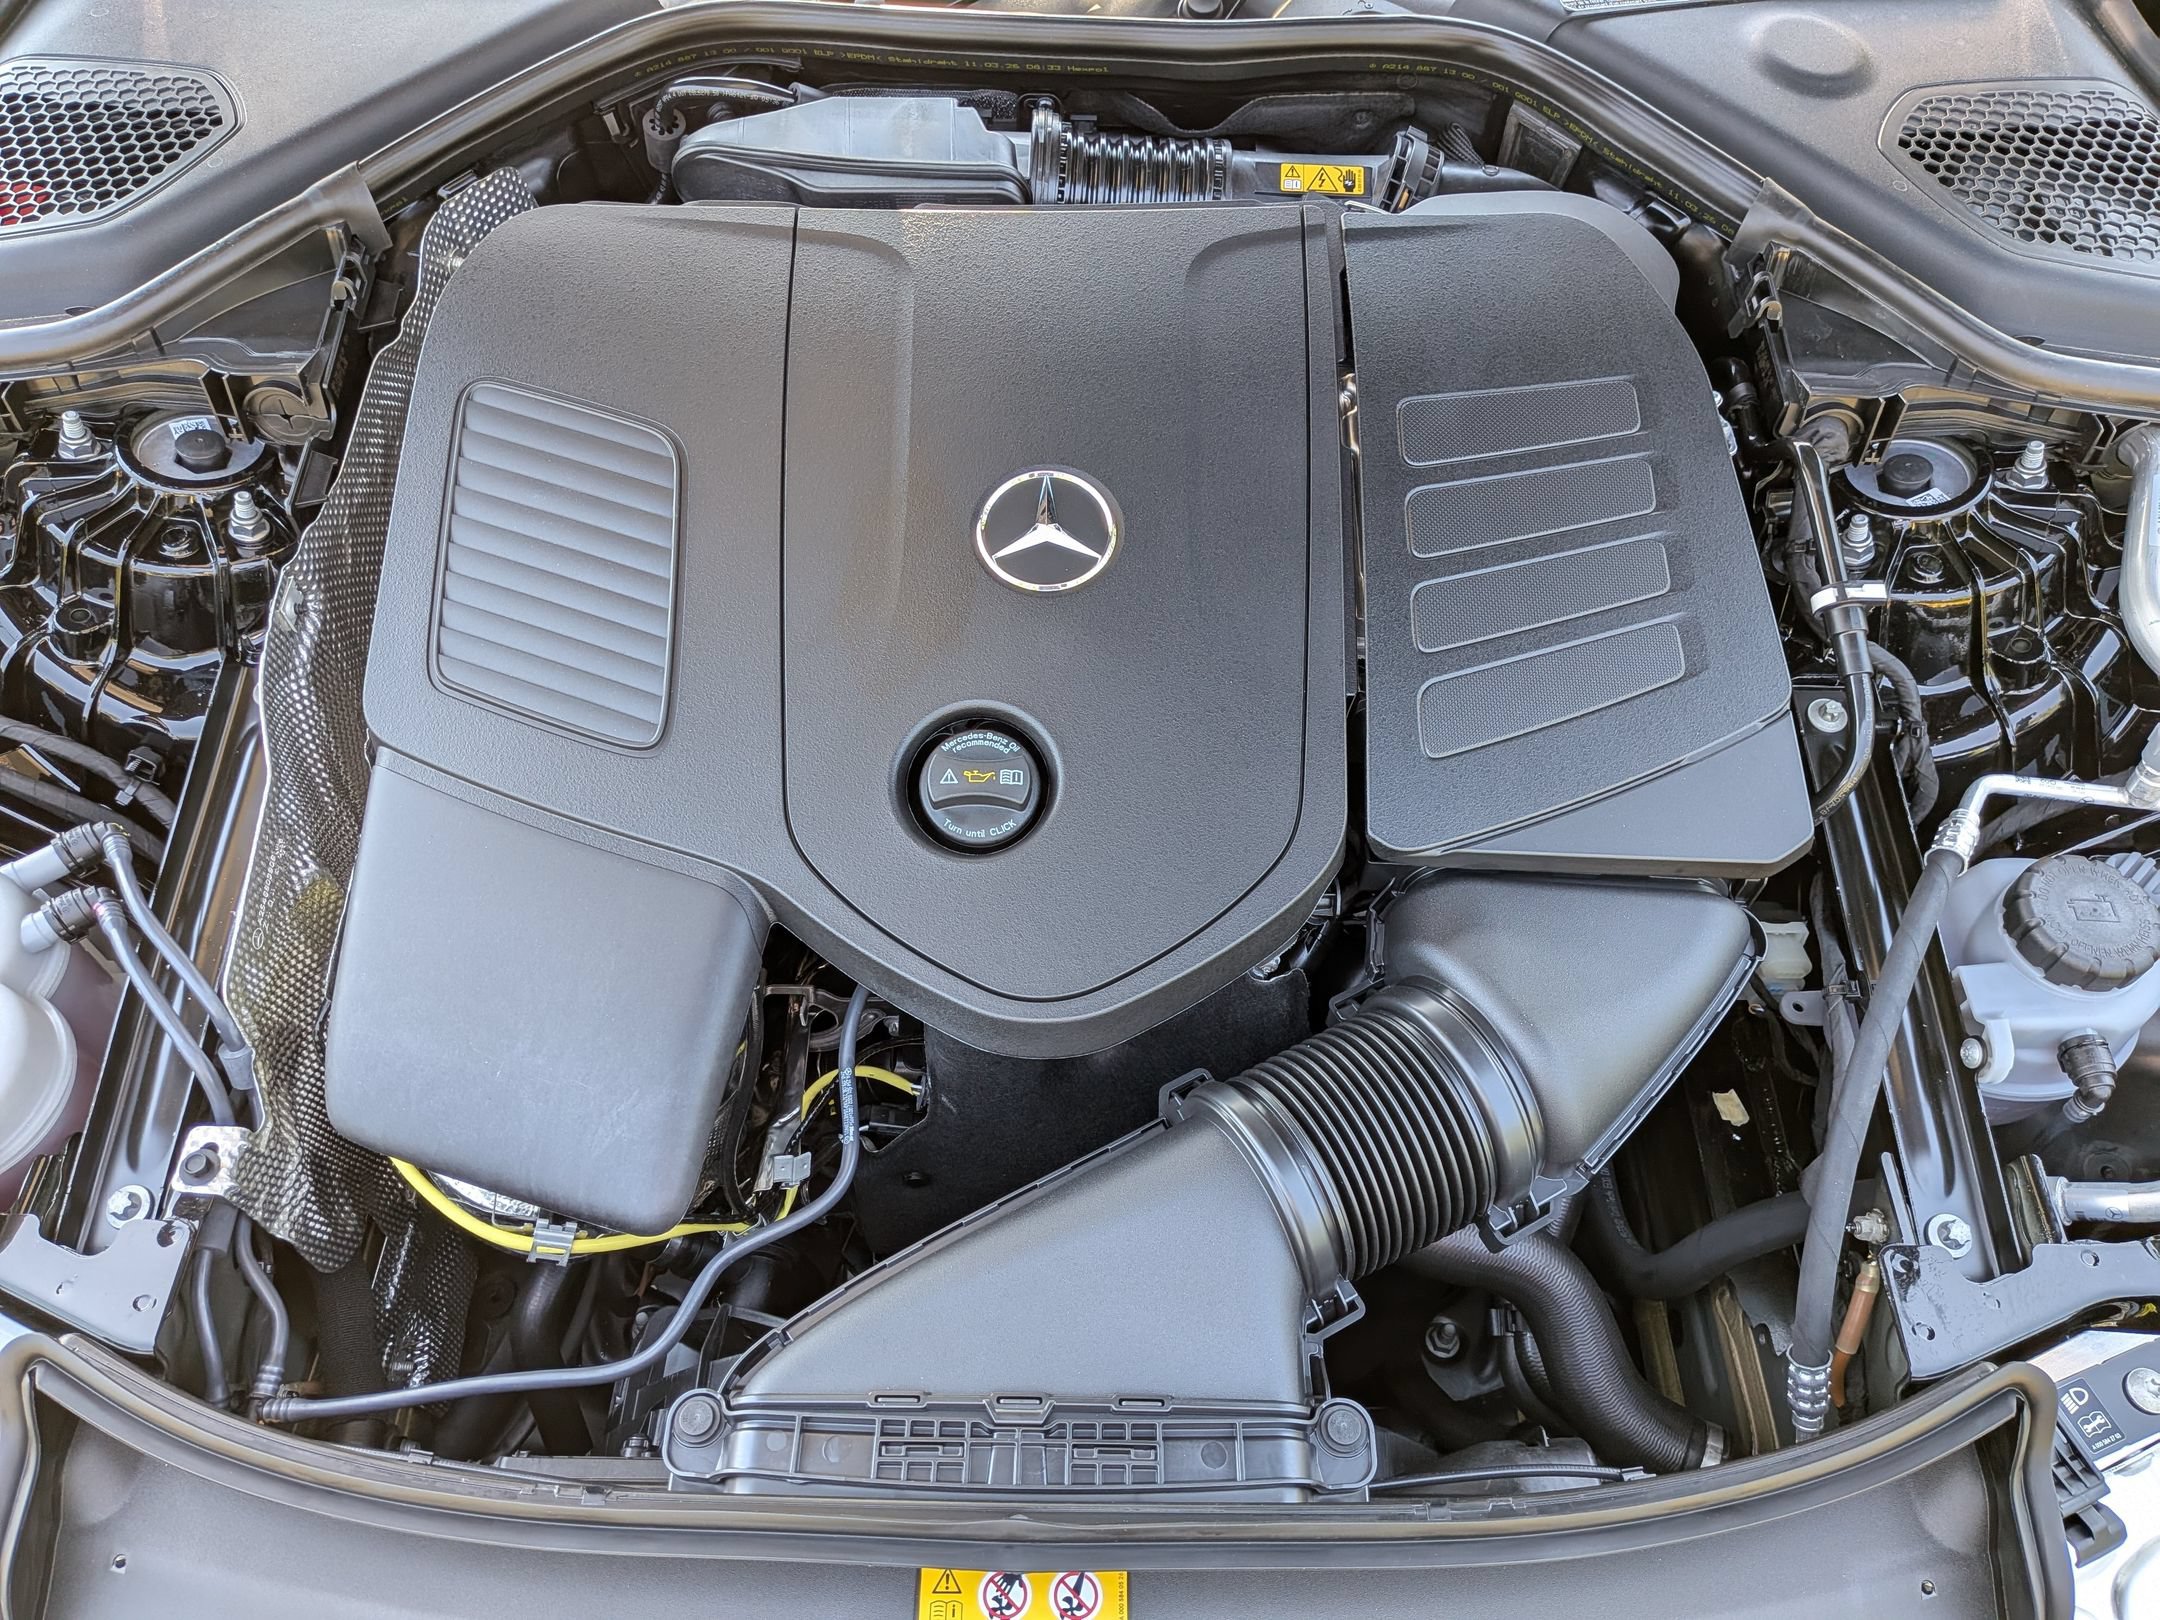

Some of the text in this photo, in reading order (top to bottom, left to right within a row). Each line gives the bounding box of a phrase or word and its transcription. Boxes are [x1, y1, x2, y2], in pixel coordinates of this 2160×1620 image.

[940, 732, 1021, 752] Mercedes-Benz Oil
[952, 739, 1011, 754] recommended
[943, 818, 1017, 838] Turn until CLICK
